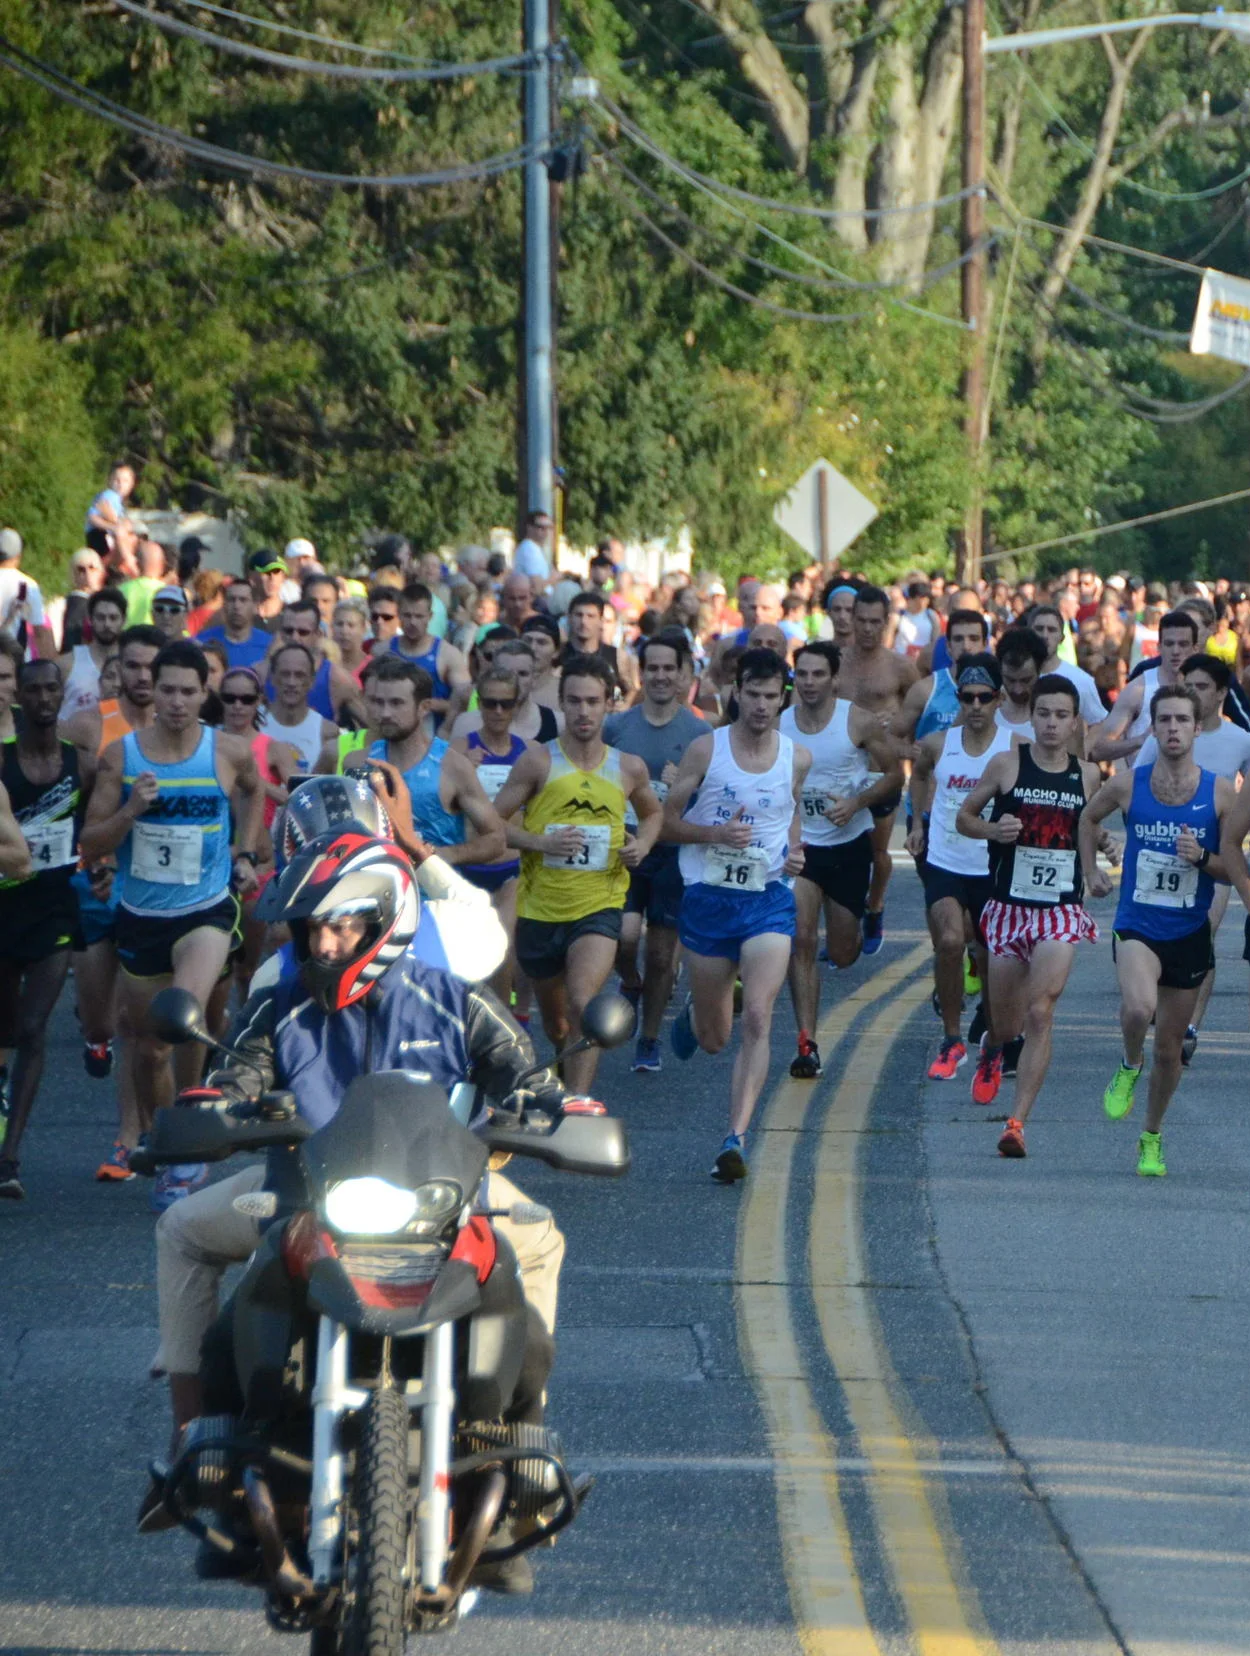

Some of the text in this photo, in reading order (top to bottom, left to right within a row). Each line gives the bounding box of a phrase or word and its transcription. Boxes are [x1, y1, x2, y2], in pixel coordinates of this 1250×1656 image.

[1014, 787, 1083, 806] MACHO MAN
[1023, 797, 1075, 809] RUNNING CLUB
[716, 804, 755, 825] tem
[804, 799, 826, 817] 56
[1134, 820, 1207, 839] gubbns
[38, 844, 52, 864] 4
[158, 845, 171, 867] 3
[724, 863, 750, 885] 16
[1031, 866, 1057, 887] 52
[1155, 871, 1180, 892] 19
